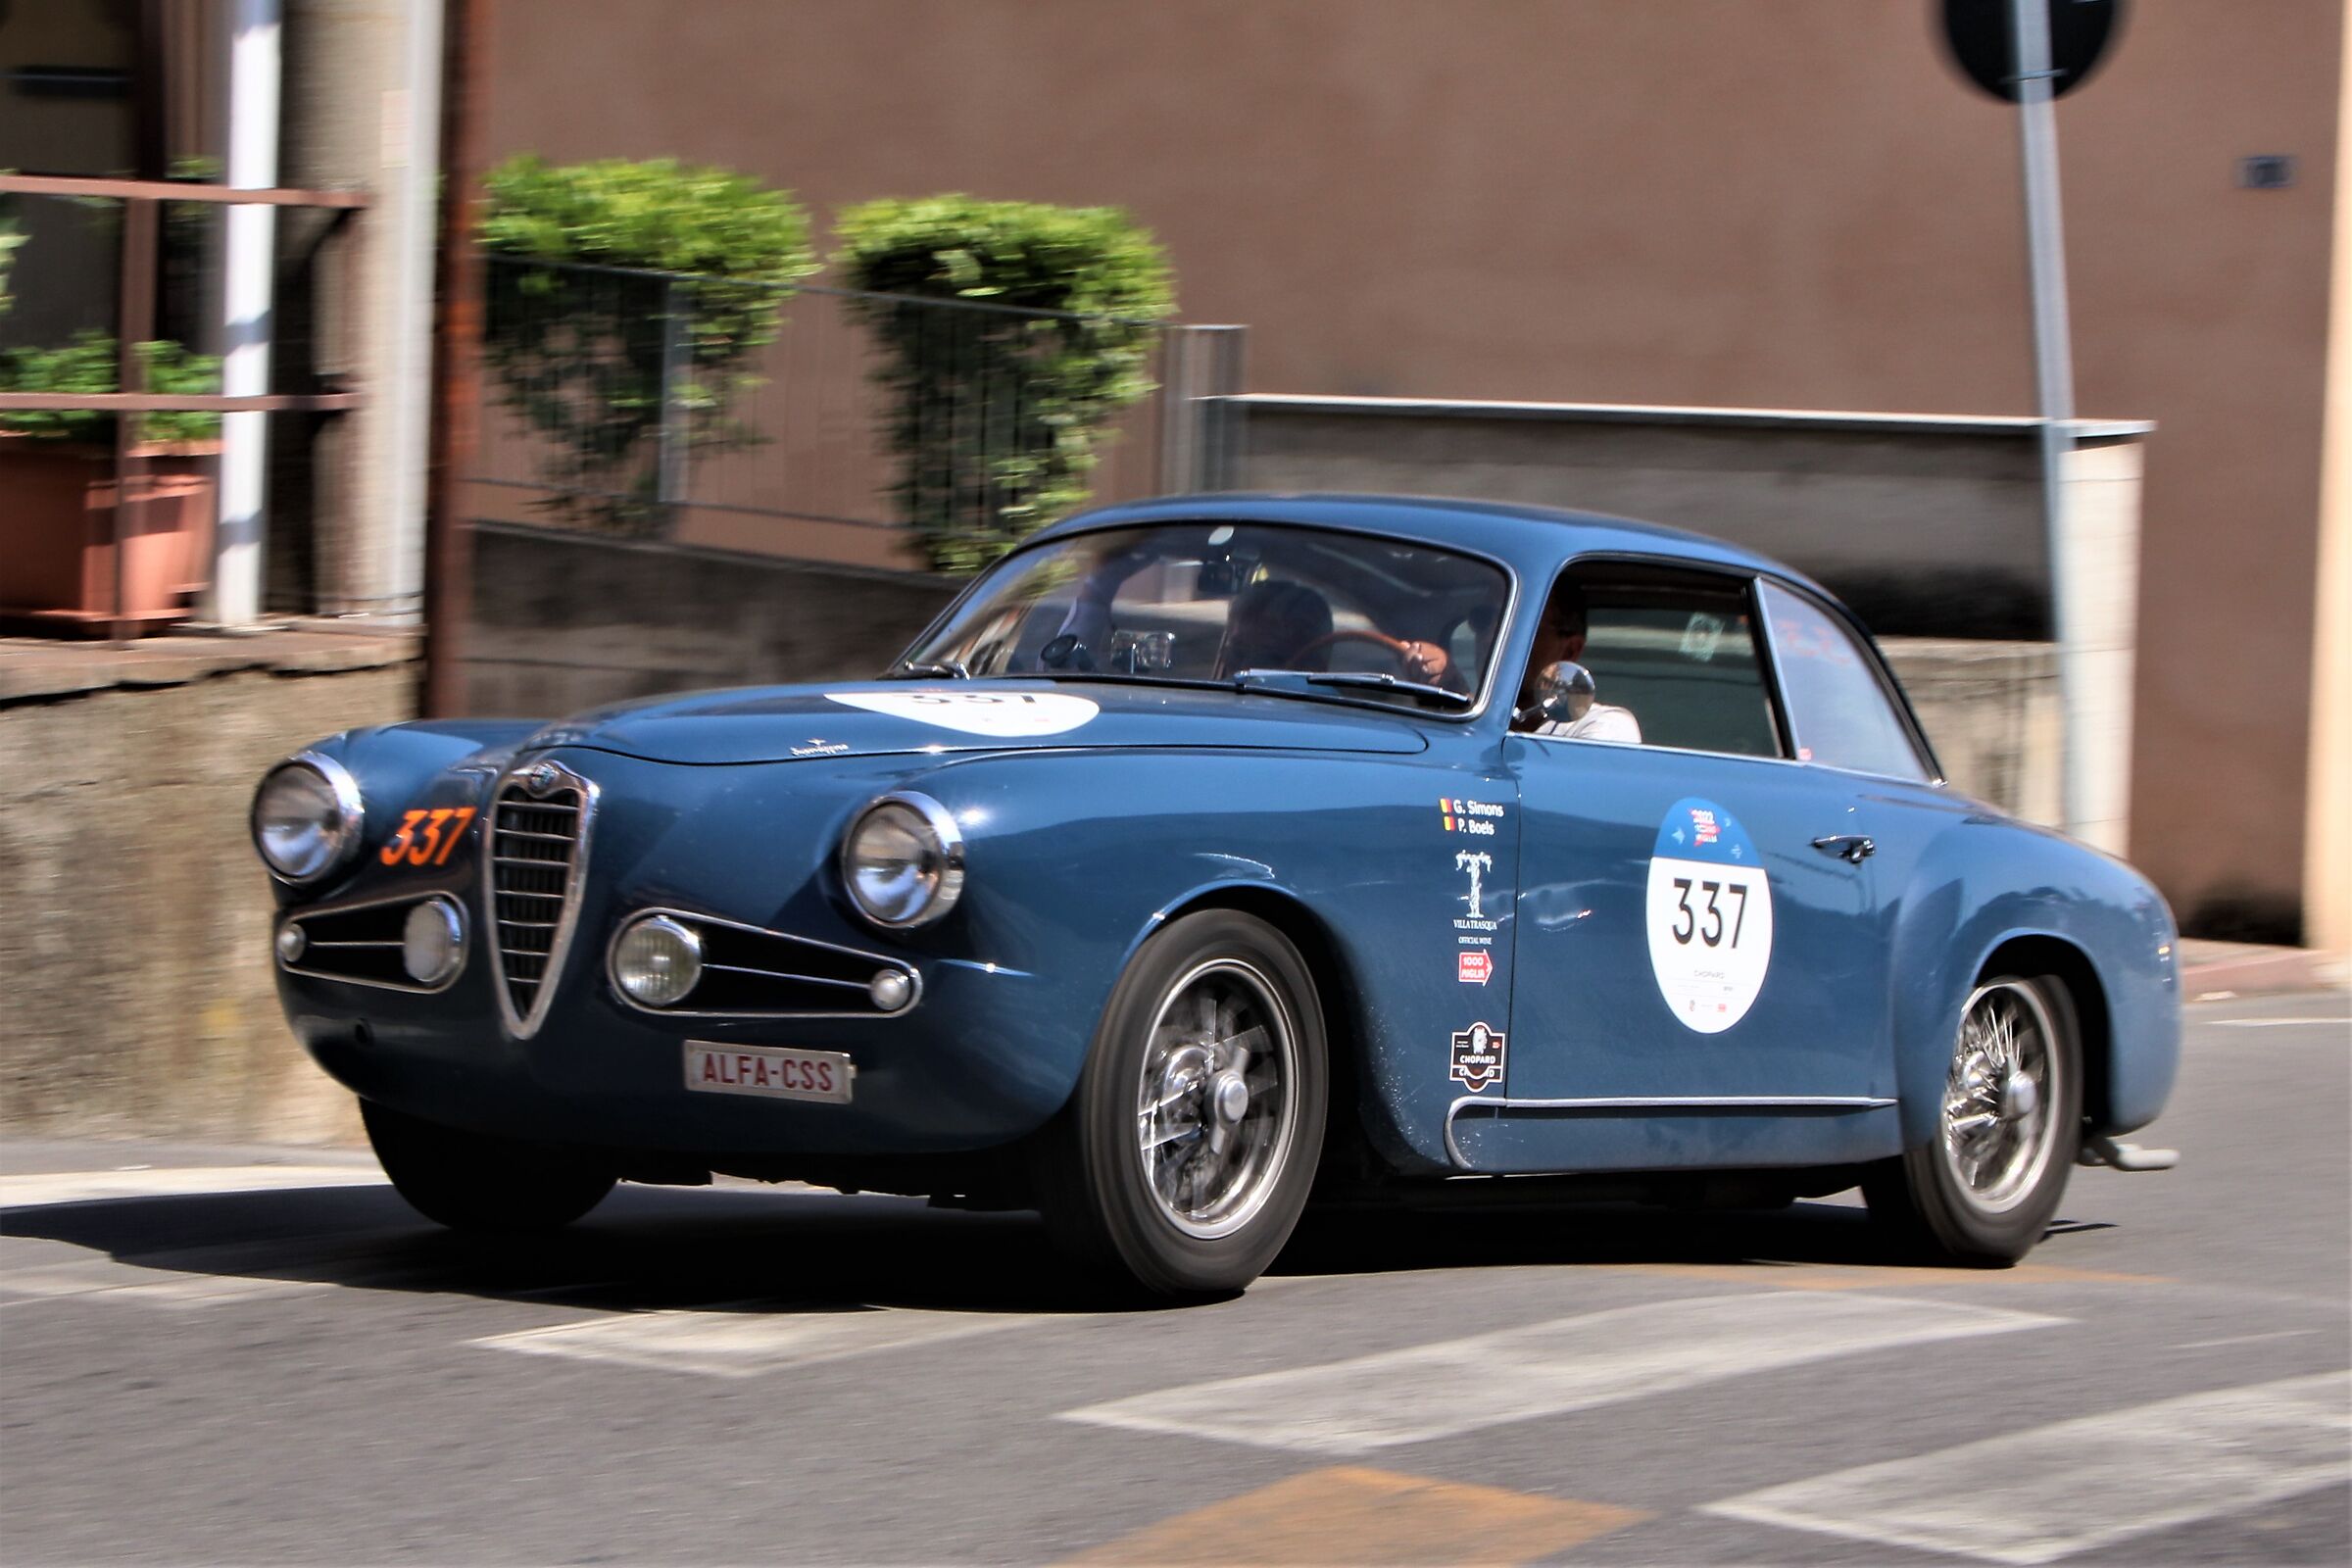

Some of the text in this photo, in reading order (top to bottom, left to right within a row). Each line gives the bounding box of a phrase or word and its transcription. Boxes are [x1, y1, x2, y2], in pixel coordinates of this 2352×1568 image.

[1453, 800, 1504, 817] G. Simons
[1457, 817, 1494, 835] P. Boels
[380, 807, 477, 866] 337
[1672, 877, 1747, 949] 337
[1453, 919, 1470, 929] VILLA
[1463, 956, 1484, 966] 1000
[1460, 1054, 1495, 1064] CHOPARD
[703, 1053, 832, 1092] ALFA-CSS
